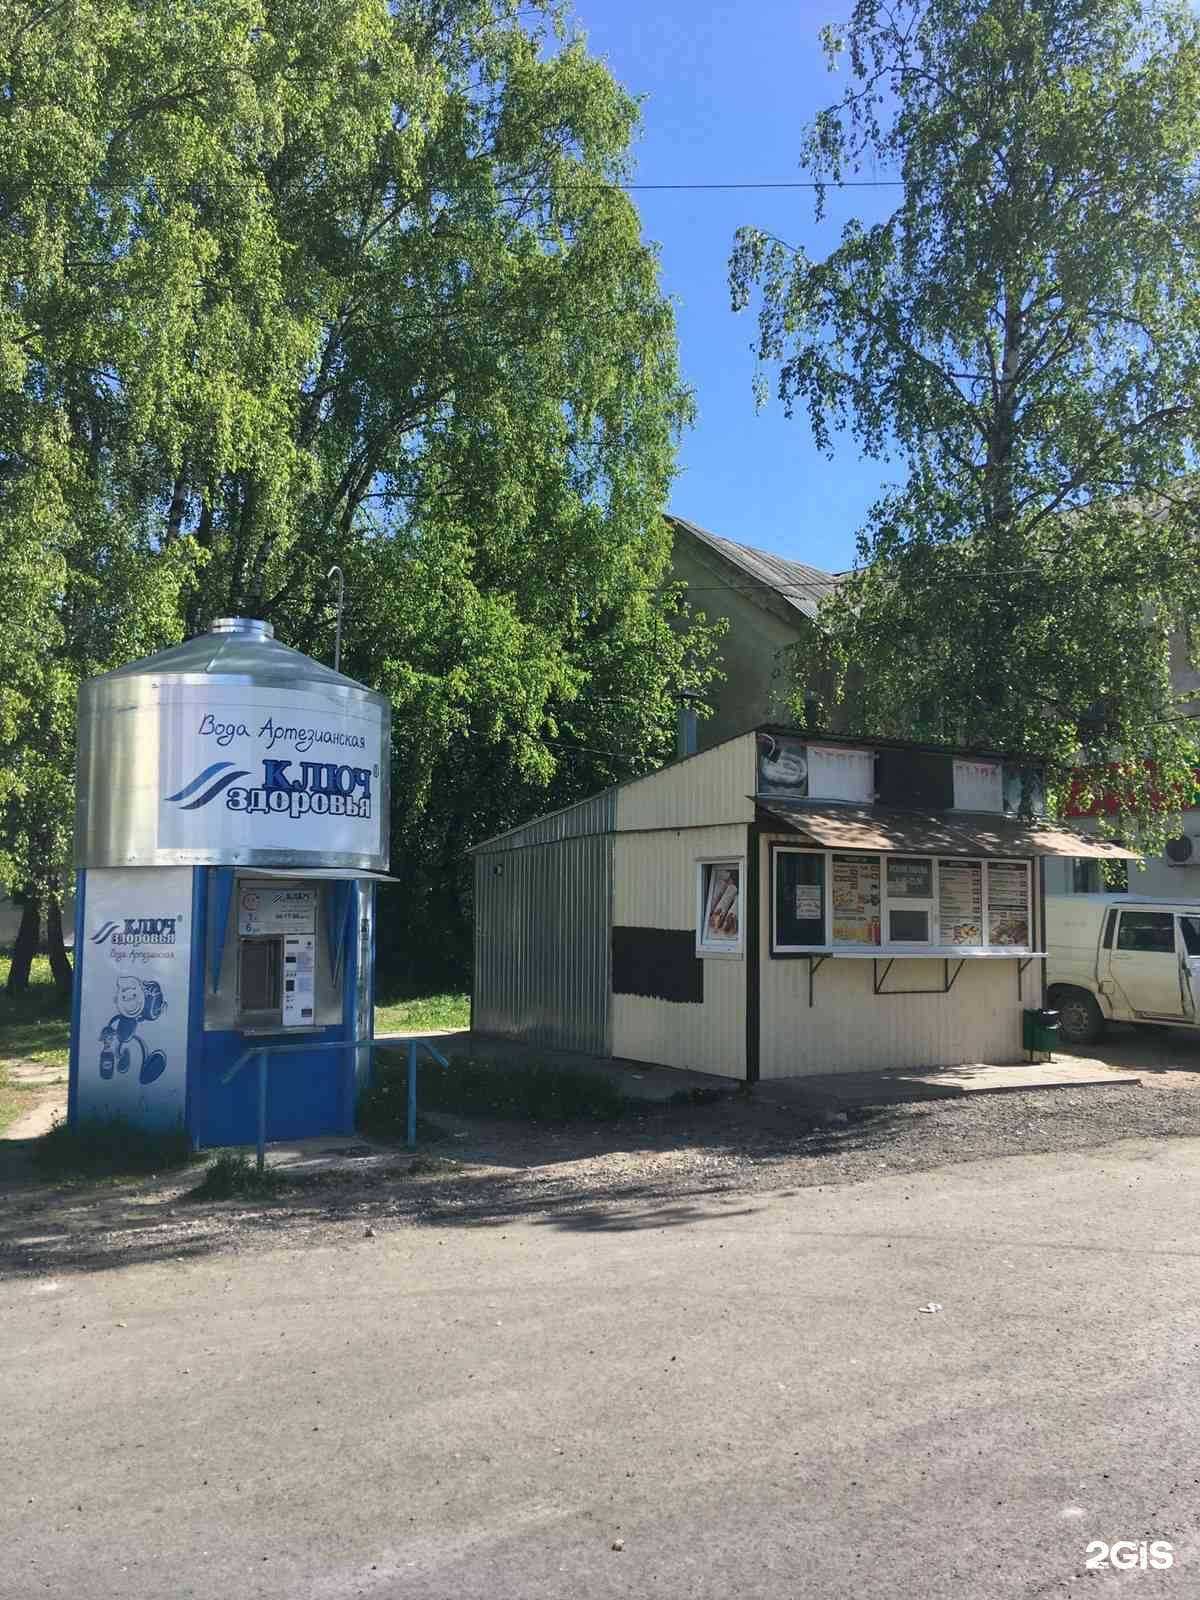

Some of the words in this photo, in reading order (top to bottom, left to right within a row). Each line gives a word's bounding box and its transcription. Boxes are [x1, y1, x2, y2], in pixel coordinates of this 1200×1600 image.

[198, 713, 251, 747] Вода
[258, 717, 367, 753] Артезианская
[262, 759, 372, 799] КЛЮЧ
